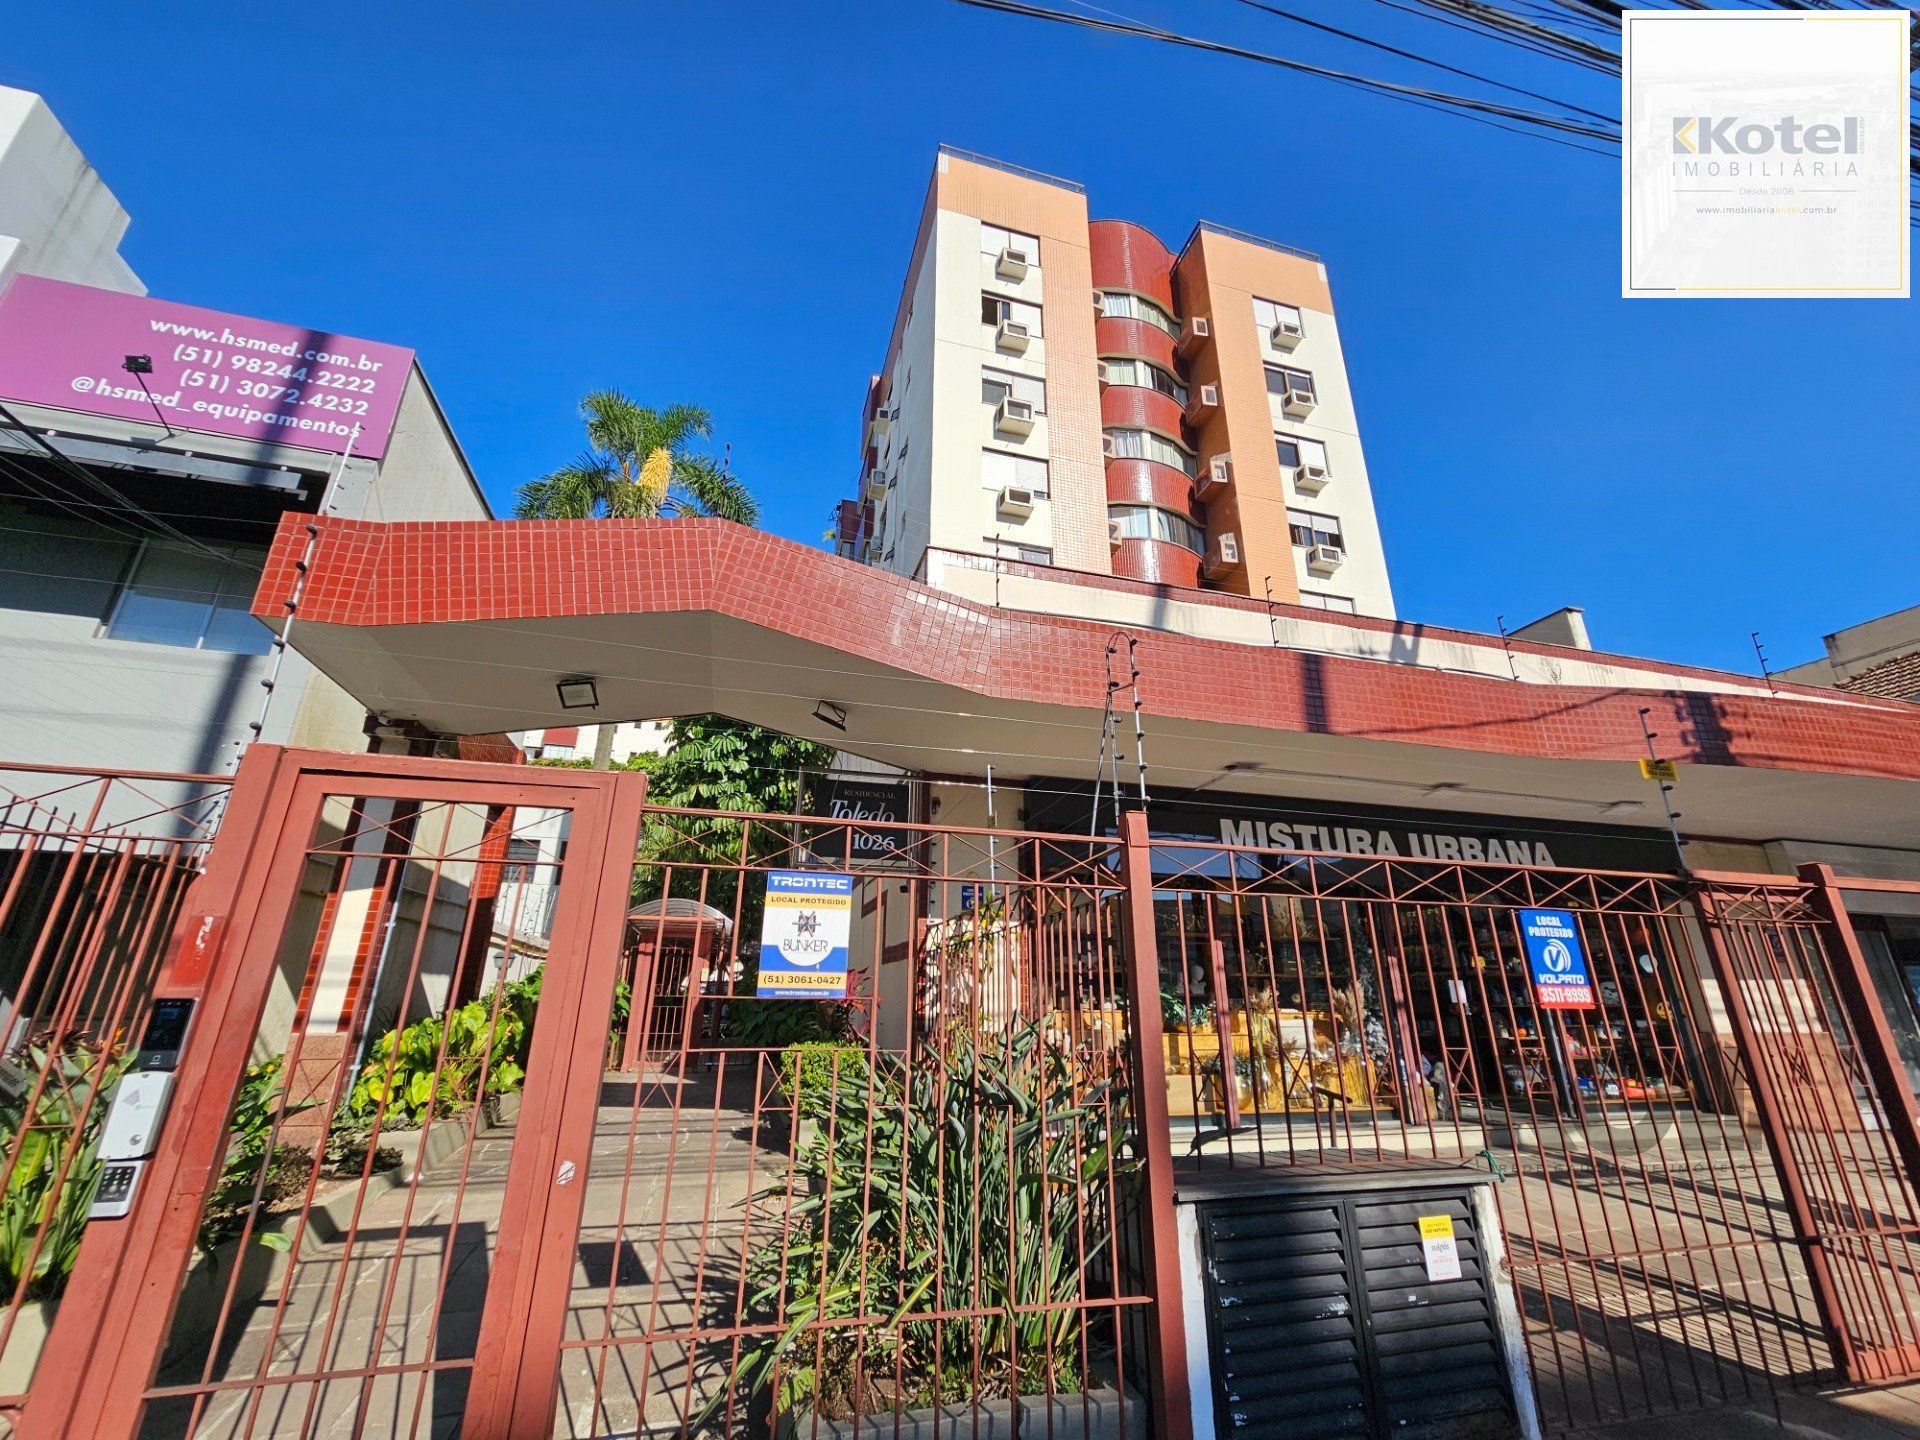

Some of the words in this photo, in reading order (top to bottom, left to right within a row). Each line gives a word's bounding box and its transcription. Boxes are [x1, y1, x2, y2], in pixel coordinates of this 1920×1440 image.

[150, 319, 383, 373] www.hsmed.com.br
[173, 342, 224, 370] (51)
[231, 354, 376, 395] 98244.2222
[180, 368, 230, 395] (51)
[237, 379, 370, 416] 3072.4232
[71, 376, 361, 440] @hsmed_equipamentos
[844, 789, 896, 800] RESIDENCIAL
[829, 799, 895, 822] Toledo
[852, 833, 897, 852] 1026
[1219, 818, 1400, 857] MISTURA
[1408, 832, 1557, 867] URBANA
[771, 876, 849, 890] TRONTEC
[771, 896, 798, 904] LOCAL
[800, 898, 847, 906] PROTEGIDO
[1535, 915, 1562, 927] LOCAL
[1528, 926, 1574, 938] PROTEGIDO
[783, 939, 829, 953] BUNKER
[763, 974, 785, 985] (51)
[788, 975, 842, 985] 3061-0427
[1538, 973, 1585, 985] VOLPATO
[1540, 987, 1592, 1003] 3511-9999
